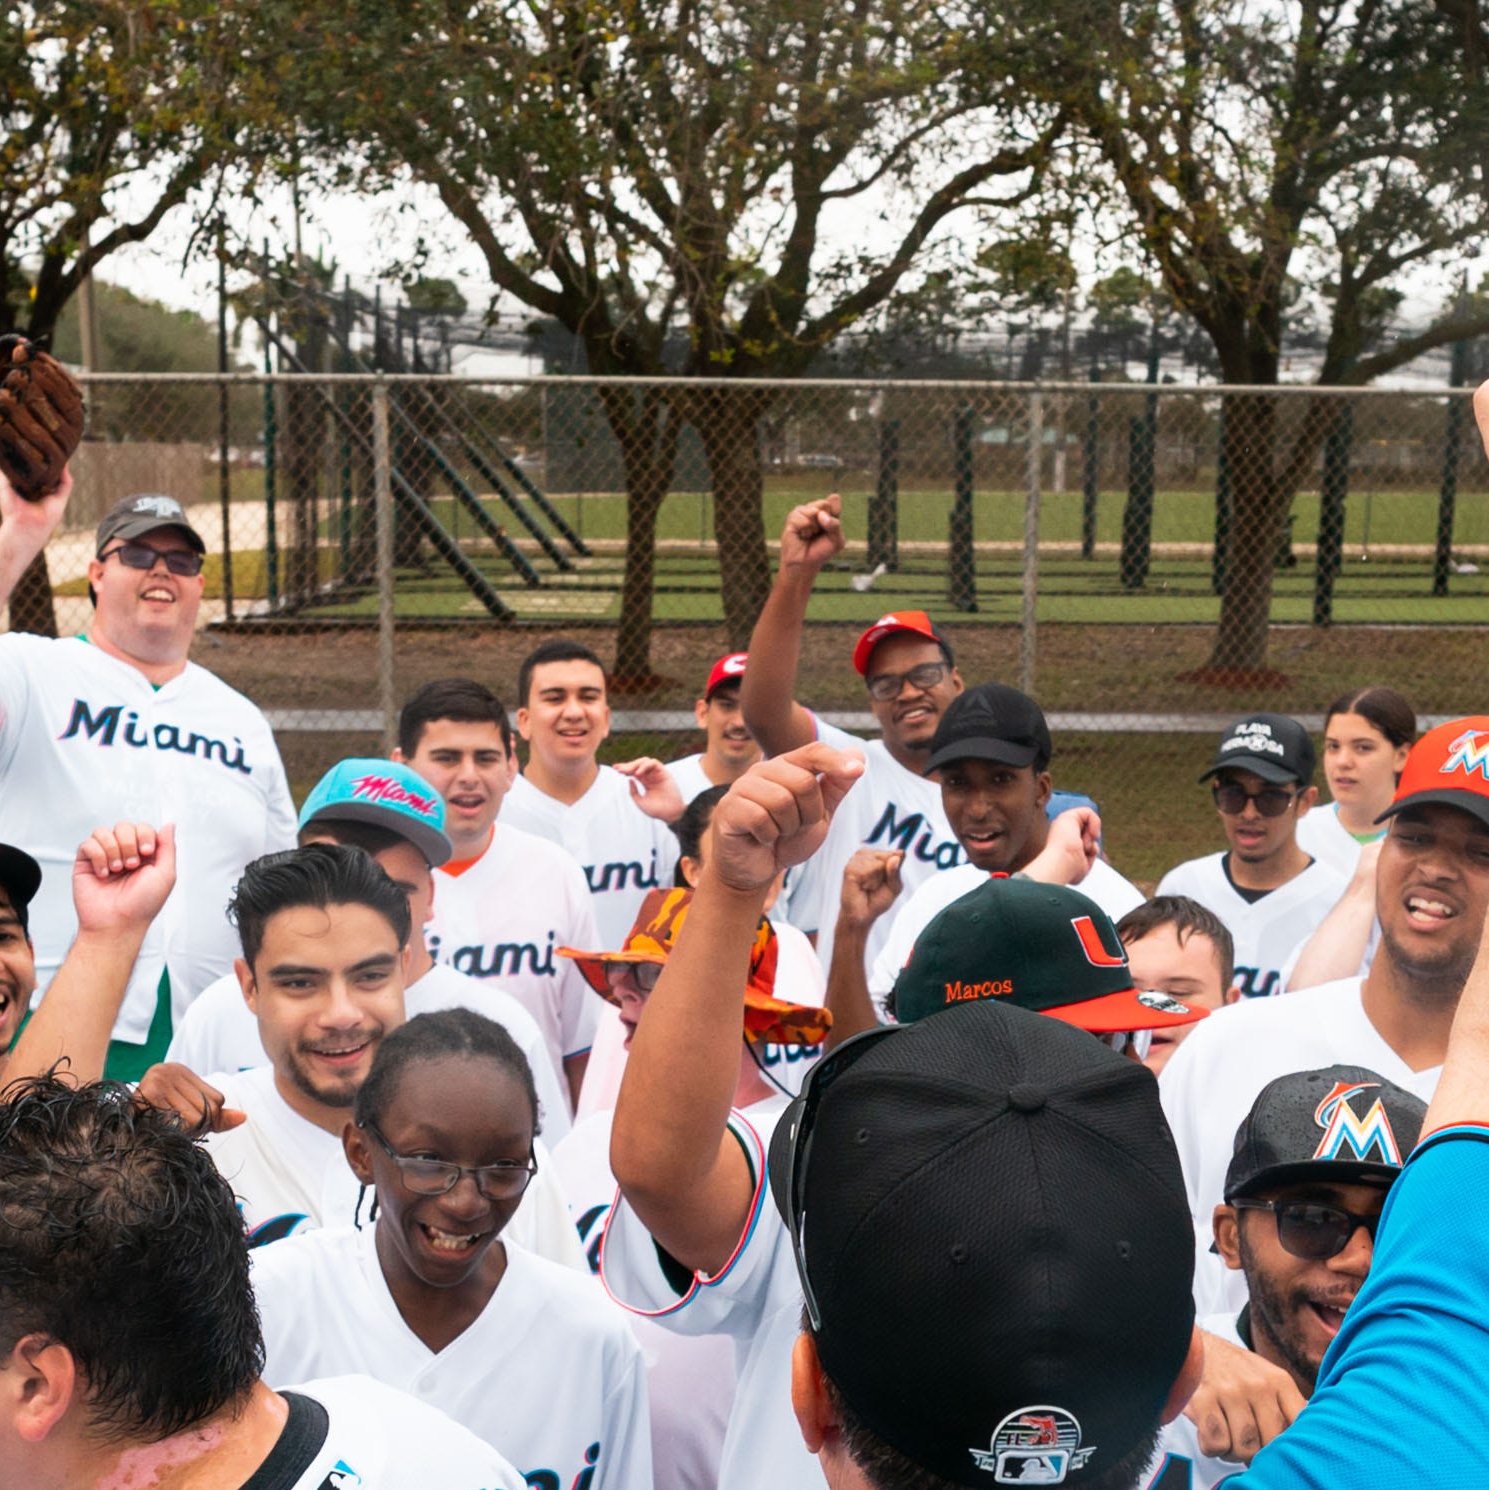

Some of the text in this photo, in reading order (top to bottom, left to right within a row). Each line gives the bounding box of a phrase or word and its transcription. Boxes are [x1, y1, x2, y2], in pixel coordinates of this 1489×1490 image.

[58, 698, 253, 775] Miami
[351, 773, 440, 817] Miami
[862, 801, 969, 870] Mia
[423, 929, 557, 979] iami
[944, 979, 1014, 1004] Marcos
